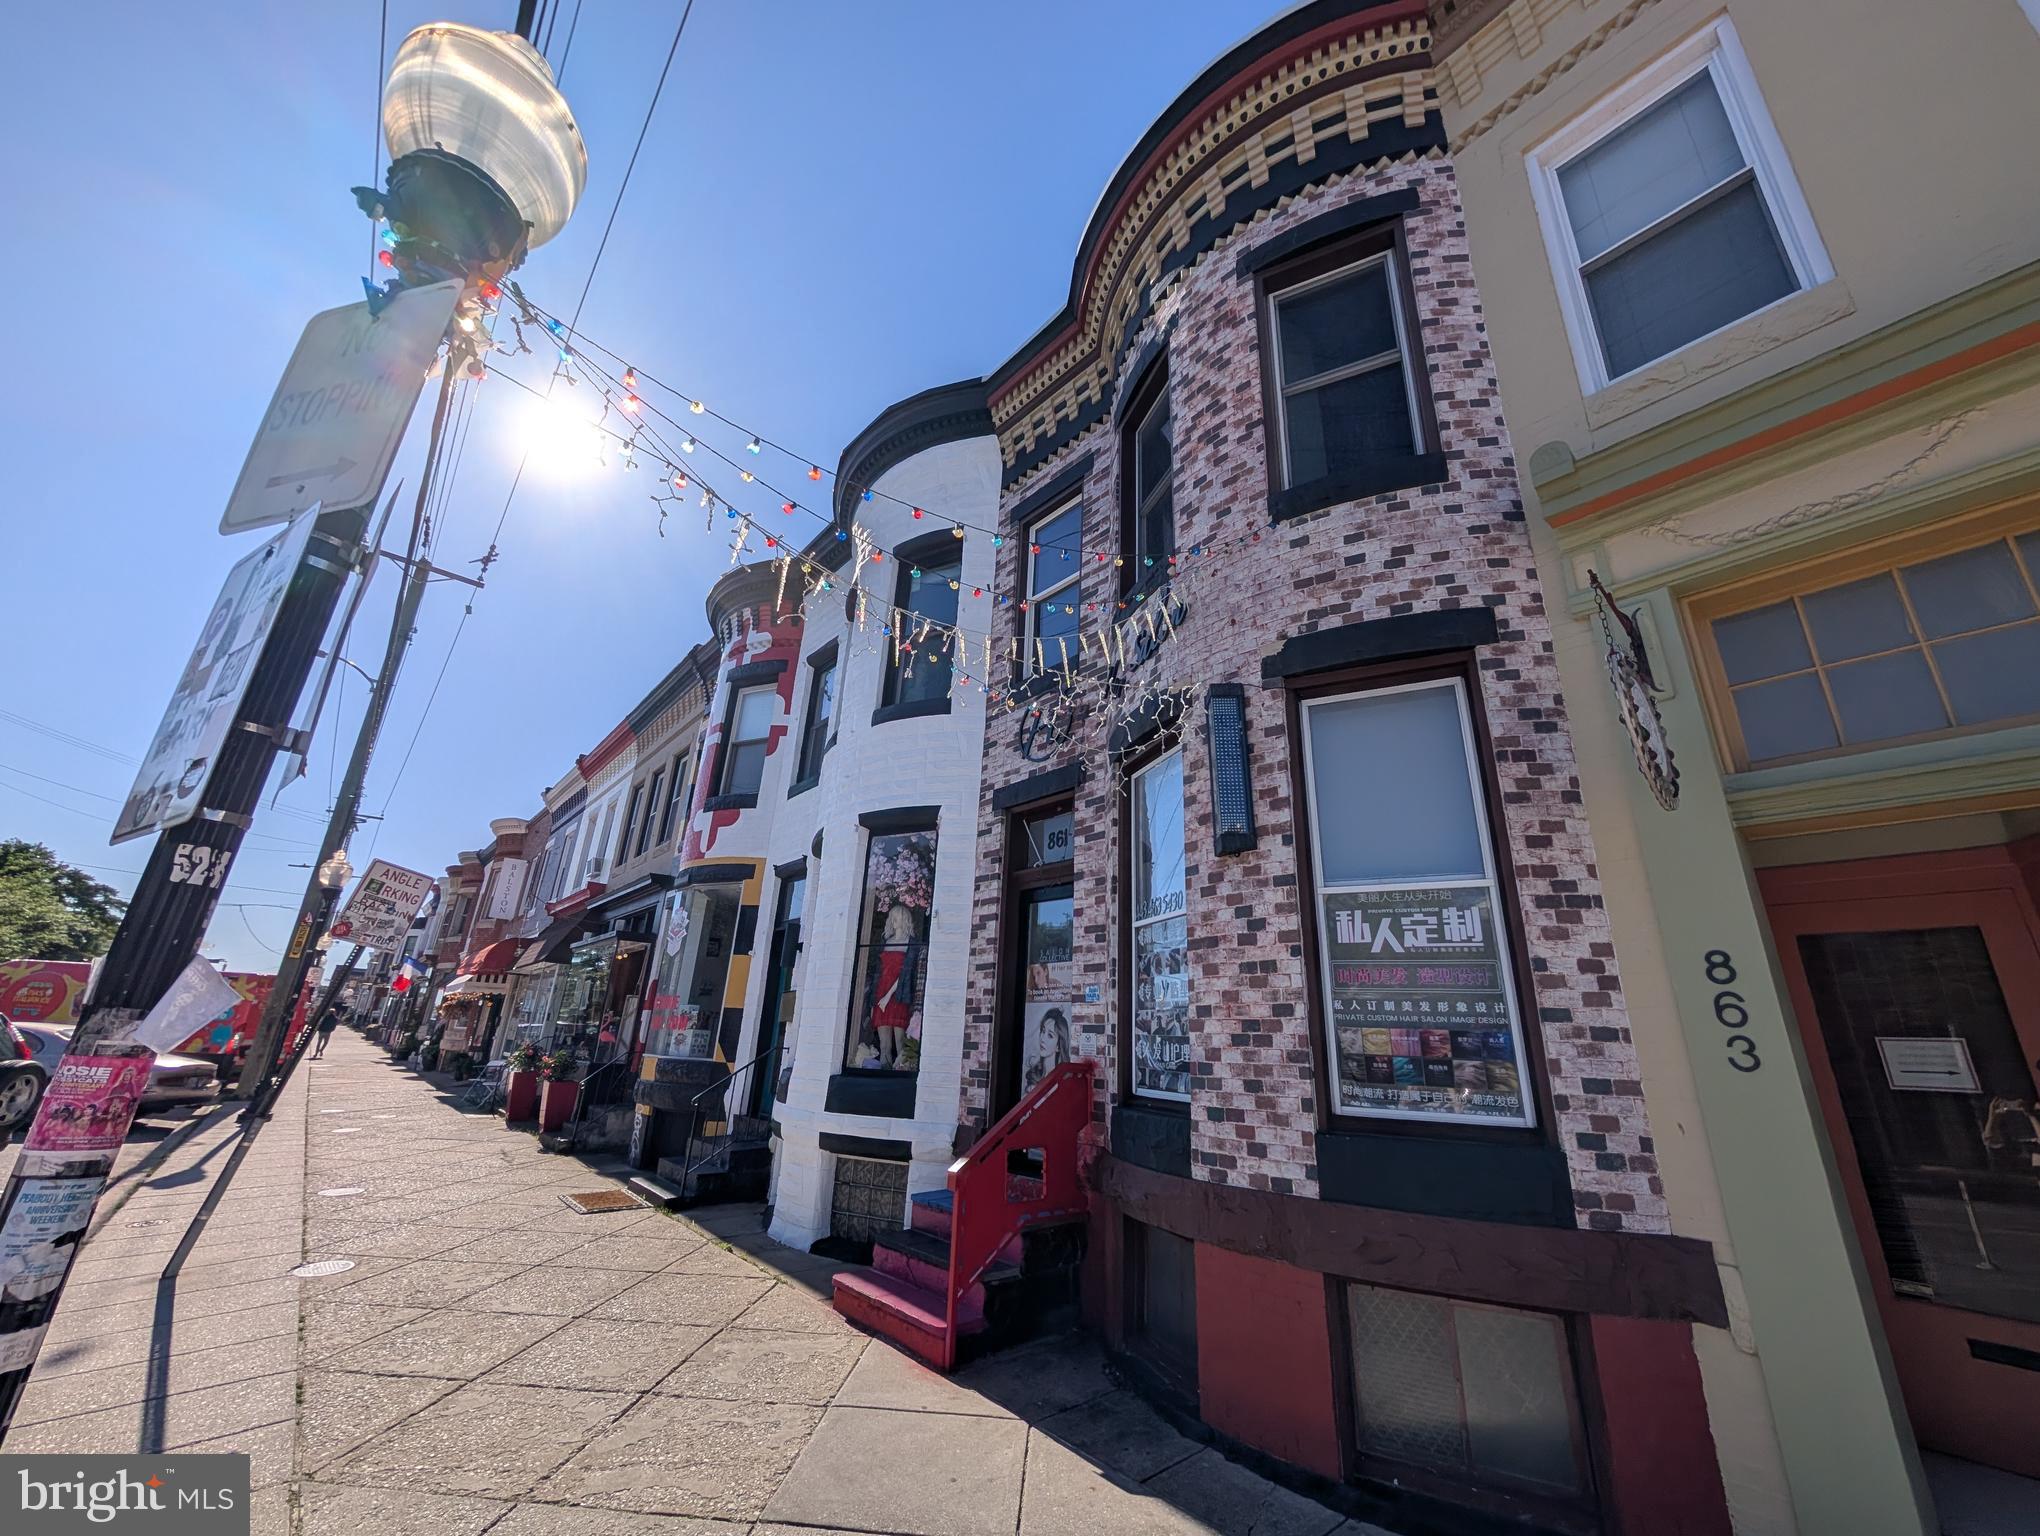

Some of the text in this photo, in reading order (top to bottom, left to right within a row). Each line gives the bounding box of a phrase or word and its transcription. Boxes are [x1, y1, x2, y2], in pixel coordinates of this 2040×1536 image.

[380, 868, 423, 889] ANGLE
[1335, 906, 1484, 953] 私人定制
[1337, 967, 1491, 986] 时尚美发 造型设计
[1334, 1000, 1507, 1014] 私人订制美发形象设计
[1704, 949, 1761, 1073] 863
[1335, 1013, 1509, 1025] PRIVATE CUSTOM HAIR SALON IMAGE DESIGN
[58, 1066, 113, 1079] JOSIE
